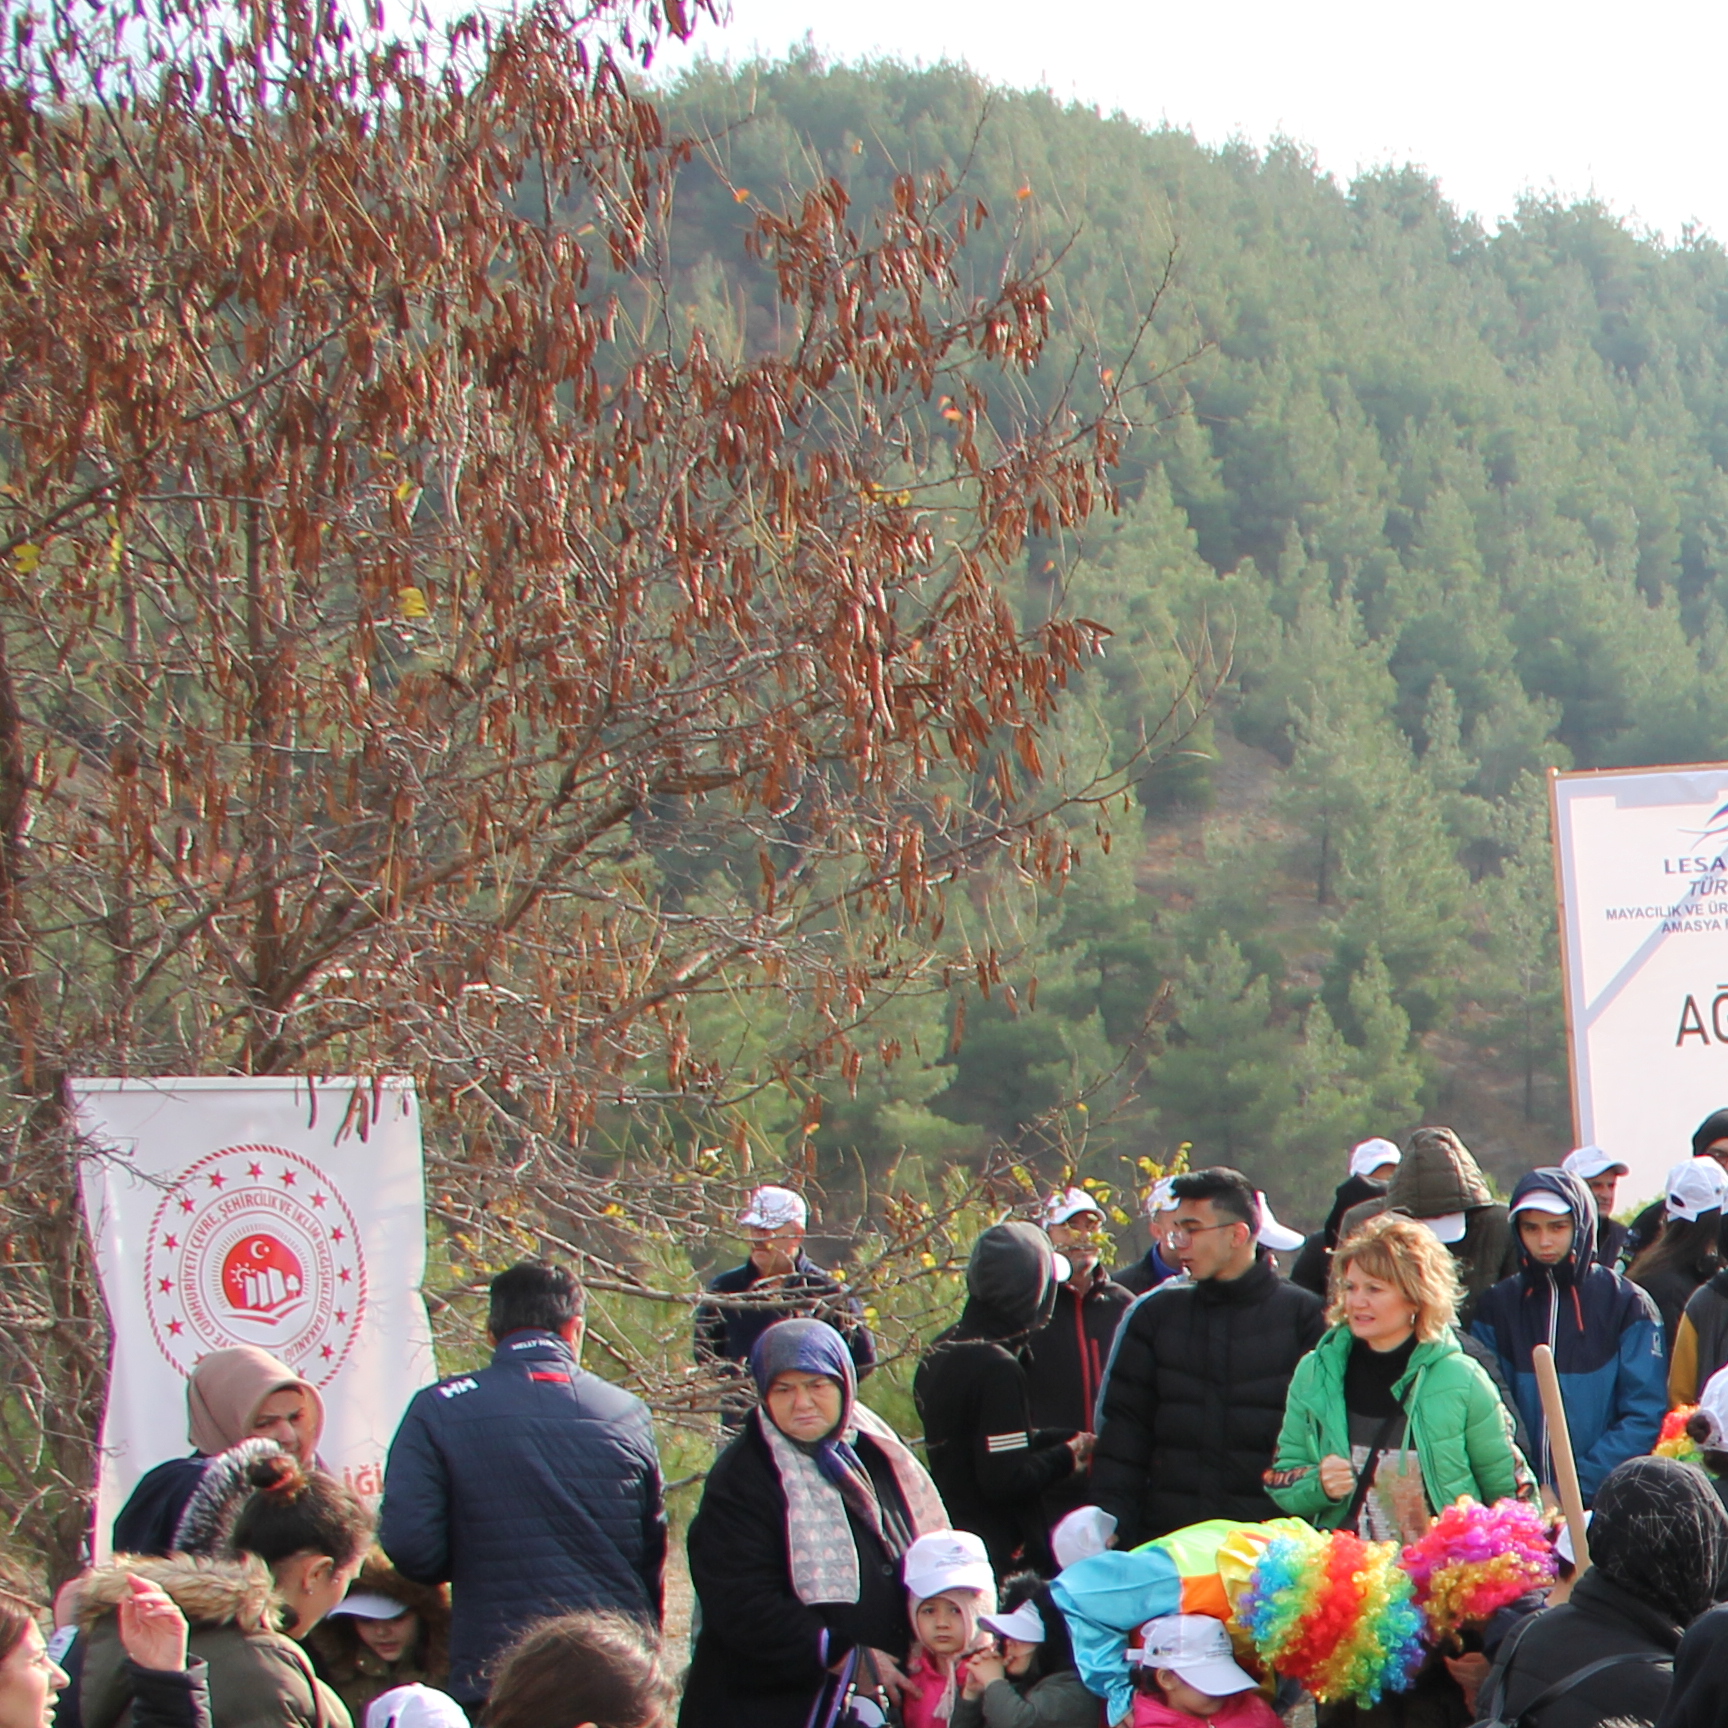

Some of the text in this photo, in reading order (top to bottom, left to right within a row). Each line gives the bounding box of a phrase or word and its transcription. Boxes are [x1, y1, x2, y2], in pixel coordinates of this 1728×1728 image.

[1606, 903, 1682, 920] MAYACILIK
[1686, 902, 1704, 916] VE
[1661, 917, 1721, 934] AMASYA
[184, 1250, 216, 1337] CUMHURİYETİ
[218, 1191, 277, 1220] ŞEHİRCİLİK
[280, 1199, 292, 1215] VE
[291, 1206, 322, 1240] İKLİM
